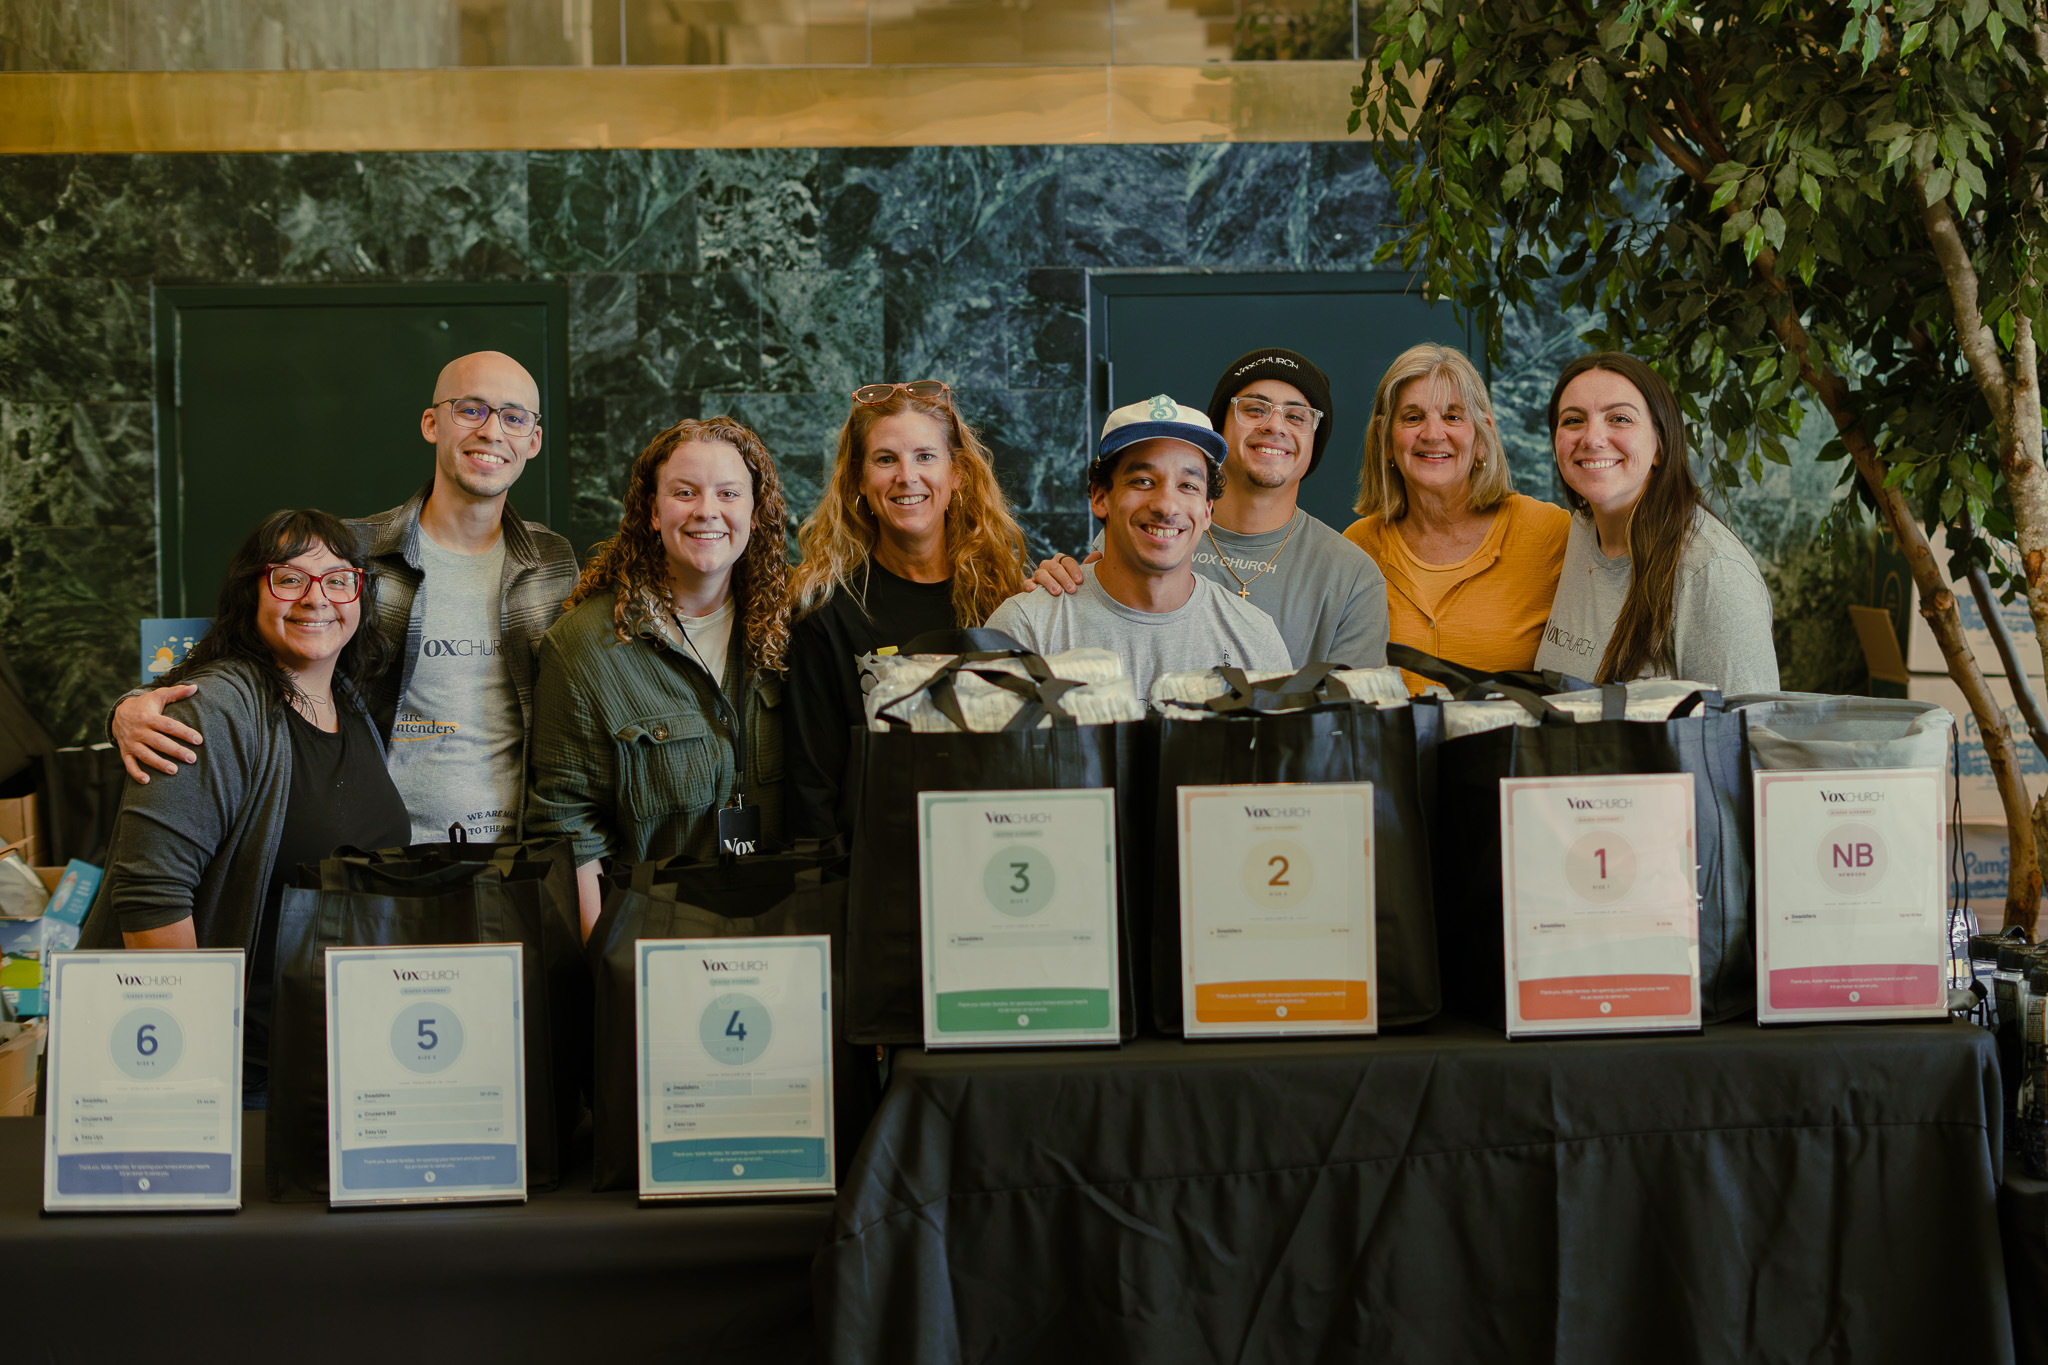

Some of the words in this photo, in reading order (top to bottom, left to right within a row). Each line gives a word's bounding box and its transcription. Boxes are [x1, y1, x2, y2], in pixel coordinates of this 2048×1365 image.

[1191, 552, 1218, 565] VOX
[1220, 556, 1277, 574] CHURCH
[395, 720, 457, 734] ntenders
[401, 711, 423, 723] are
[467, 812, 484, 821] WE
[485, 810, 504, 819] ARE
[468, 827, 482, 836] TO
[483, 825, 502, 834] THE
[1594, 848, 1607, 879] 1
[1833, 843, 1875, 869] NB
[1009, 861, 1031, 894] 3
[1268, 855, 1290, 887] 2
[136, 1024, 158, 1056] 6
[417, 1019, 439, 1051] 5
[725, 1010, 747, 1042] 4
